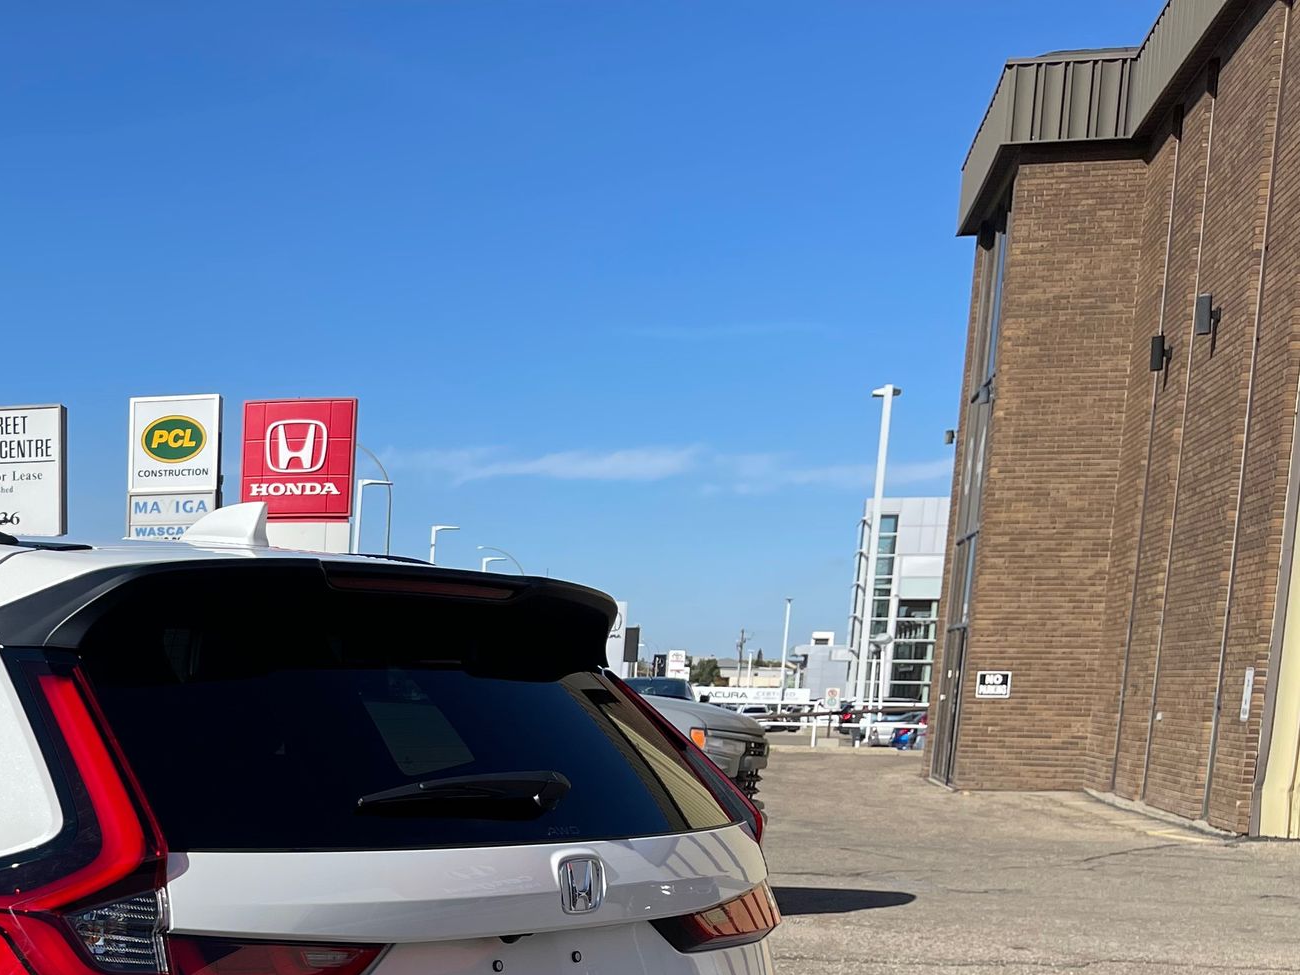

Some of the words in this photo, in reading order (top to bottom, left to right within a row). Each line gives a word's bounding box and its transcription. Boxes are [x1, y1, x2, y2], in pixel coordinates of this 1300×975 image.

[151, 428, 197, 449] PCL
[0, 438, 52, 459] CENTRE
[12, 470, 43, 481] Lease
[138, 468, 209, 478] CONSTRUCTION
[249, 482, 340, 497] HONDA
[135, 526, 190, 537] WASCA
[984, 673, 1004, 685] NO
[708, 691, 748, 699] ACURA
